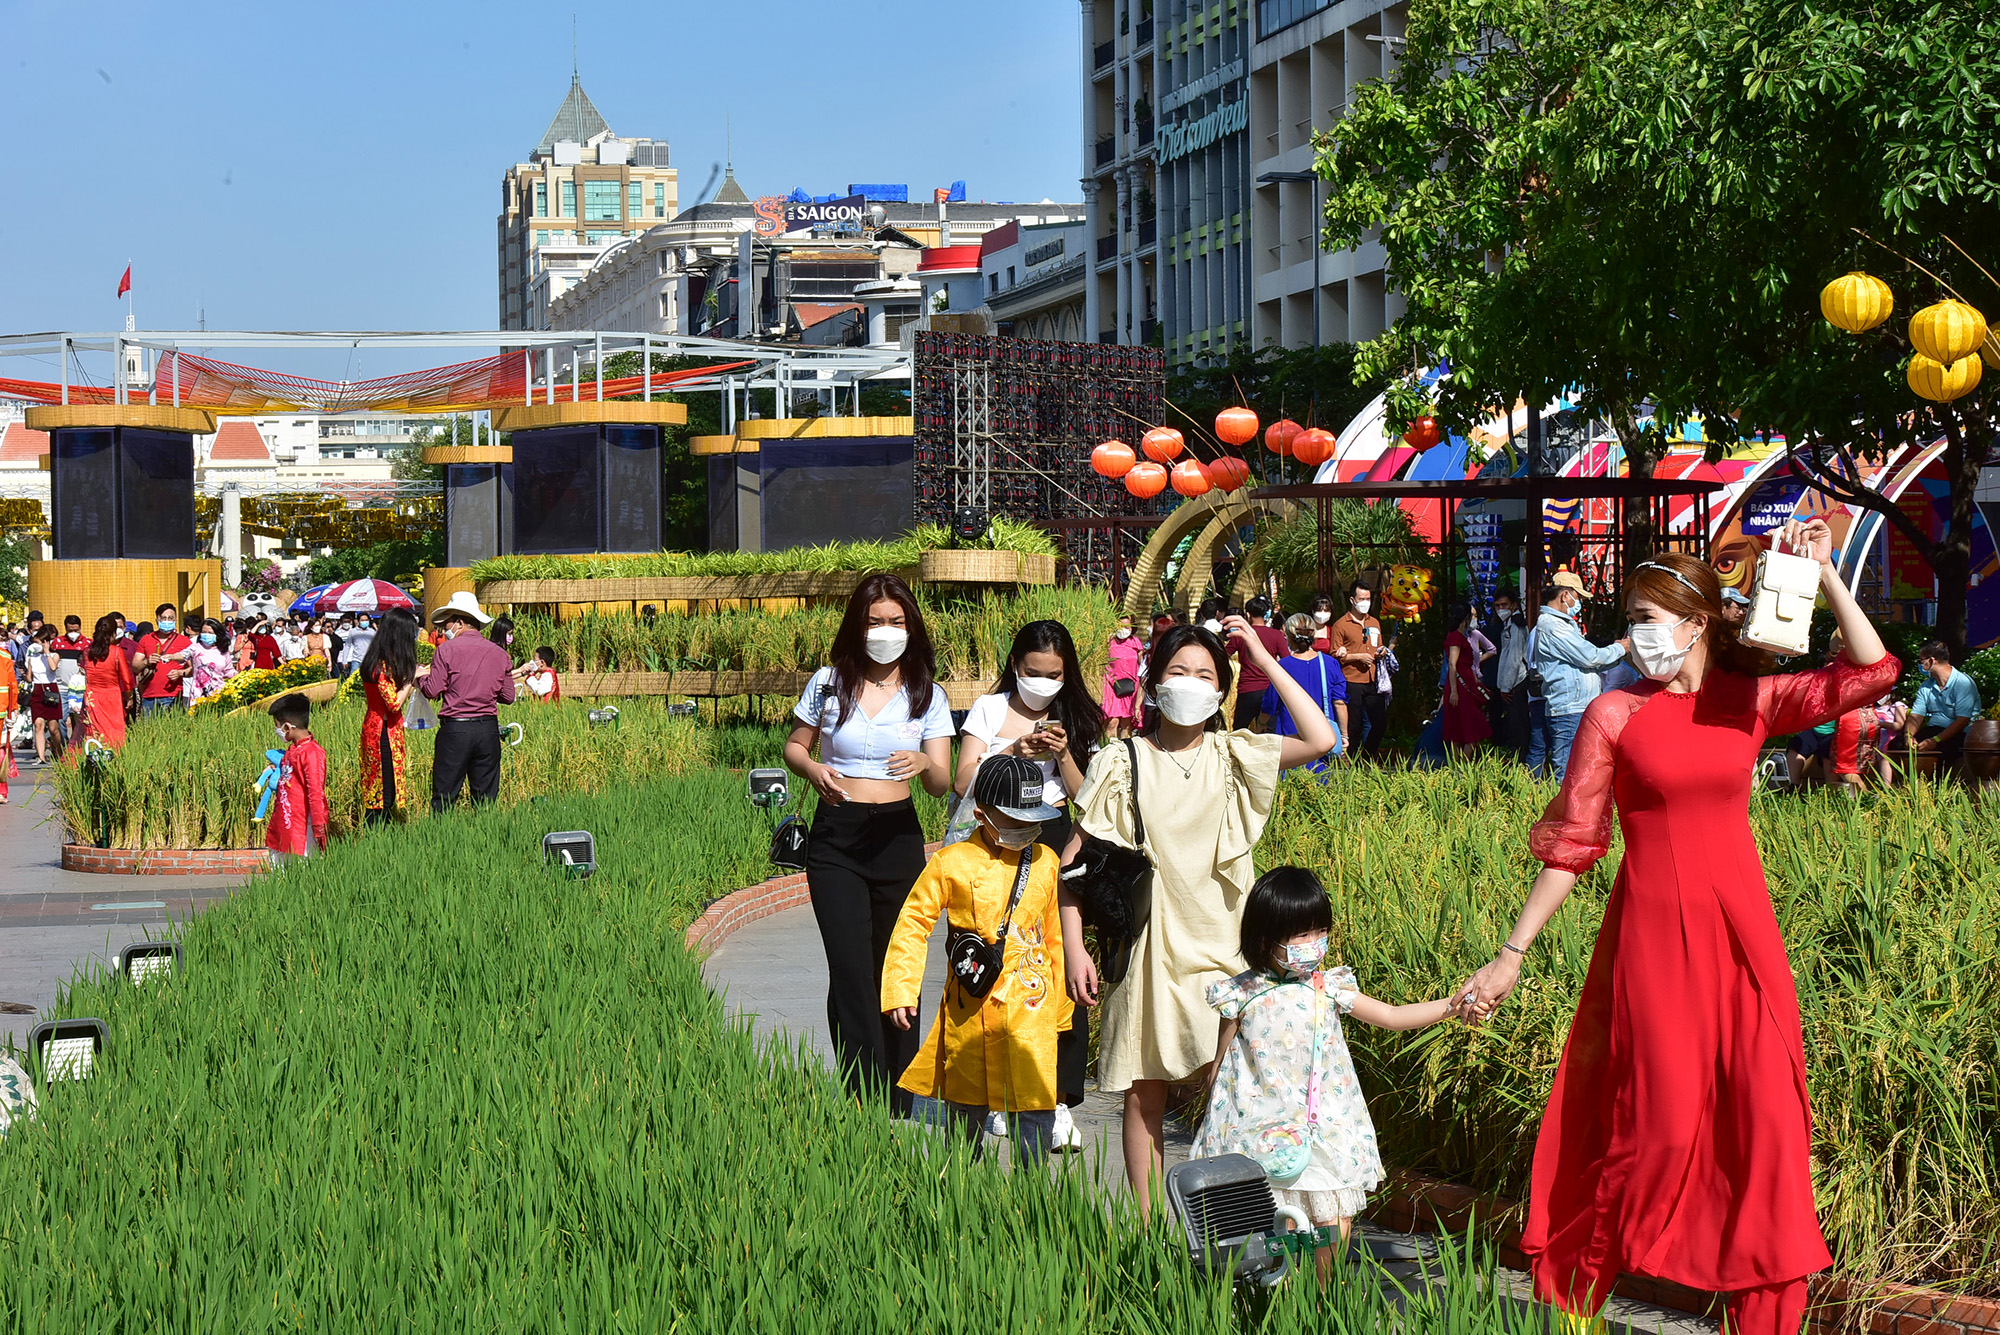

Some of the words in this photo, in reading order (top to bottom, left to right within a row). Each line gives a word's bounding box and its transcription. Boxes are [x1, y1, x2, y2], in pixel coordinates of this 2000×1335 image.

[797, 206, 862, 220] SAIGON
[1750, 501, 1773, 513] BÁO
[1773, 501, 1797, 513] XUÂ
[1750, 514, 1779, 526] NHÂM
